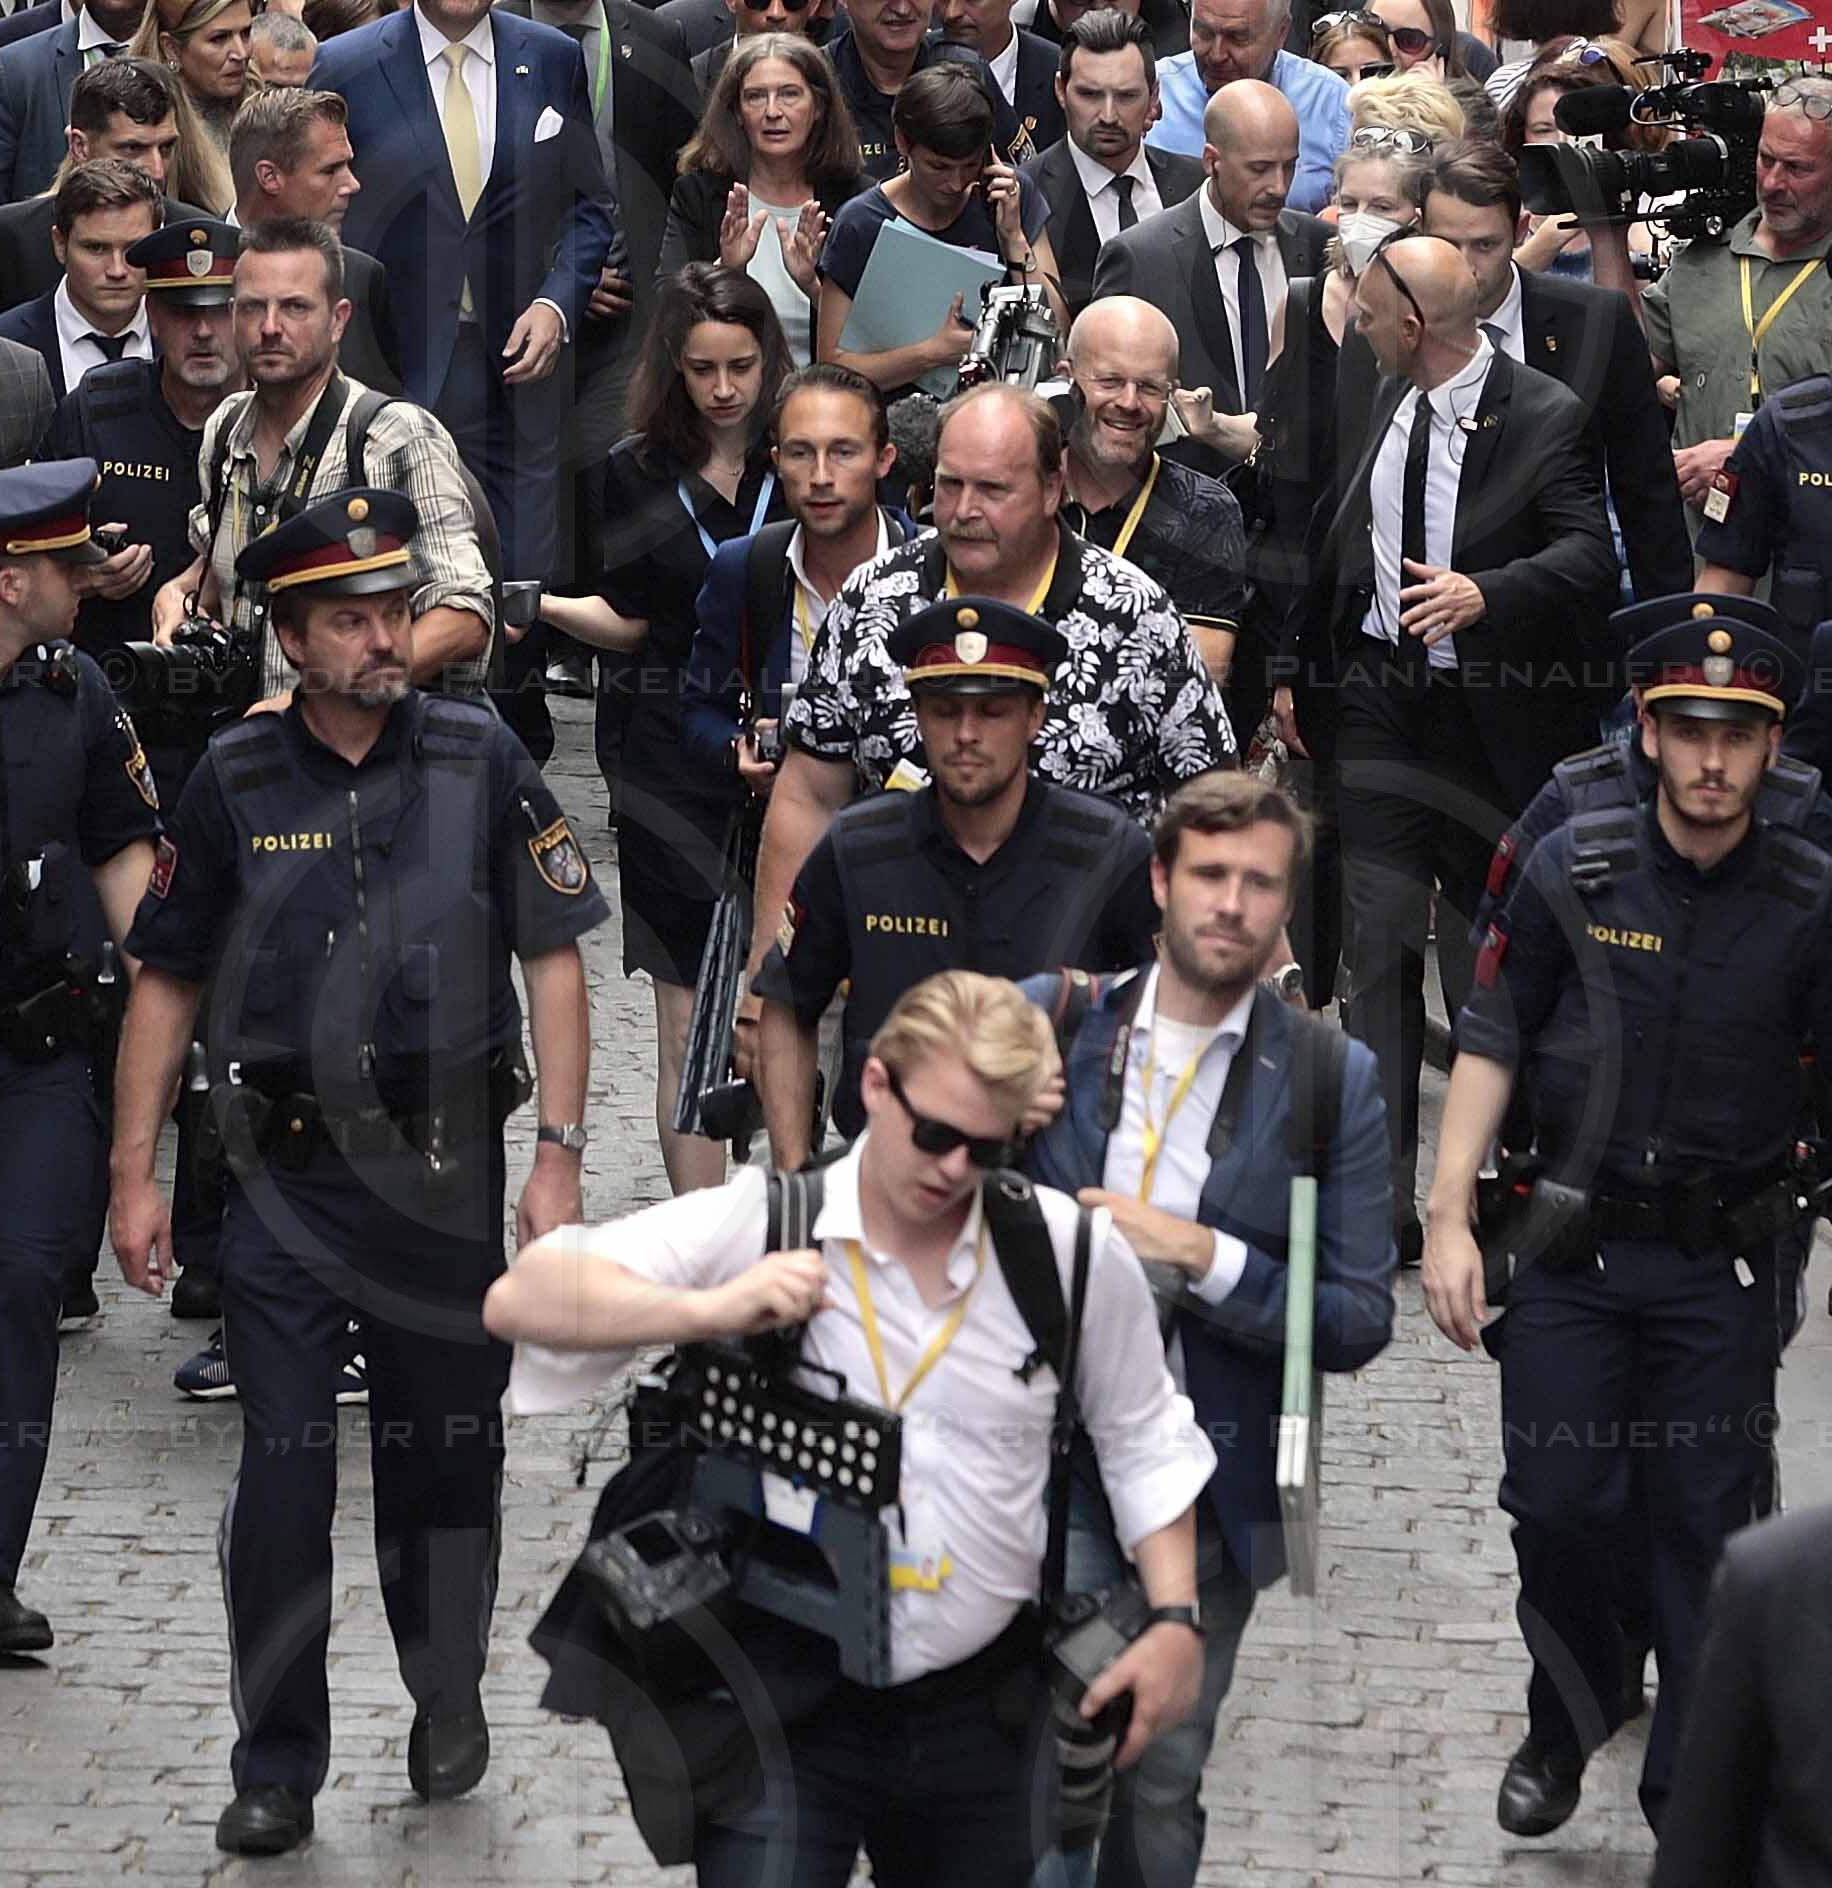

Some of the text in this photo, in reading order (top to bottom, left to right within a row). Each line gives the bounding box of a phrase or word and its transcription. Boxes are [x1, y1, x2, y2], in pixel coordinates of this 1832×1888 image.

[102, 460, 170, 481] POLIZEI
[251, 831, 333, 854] POLIZEI
[865, 914, 949, 936] POLIZEI
